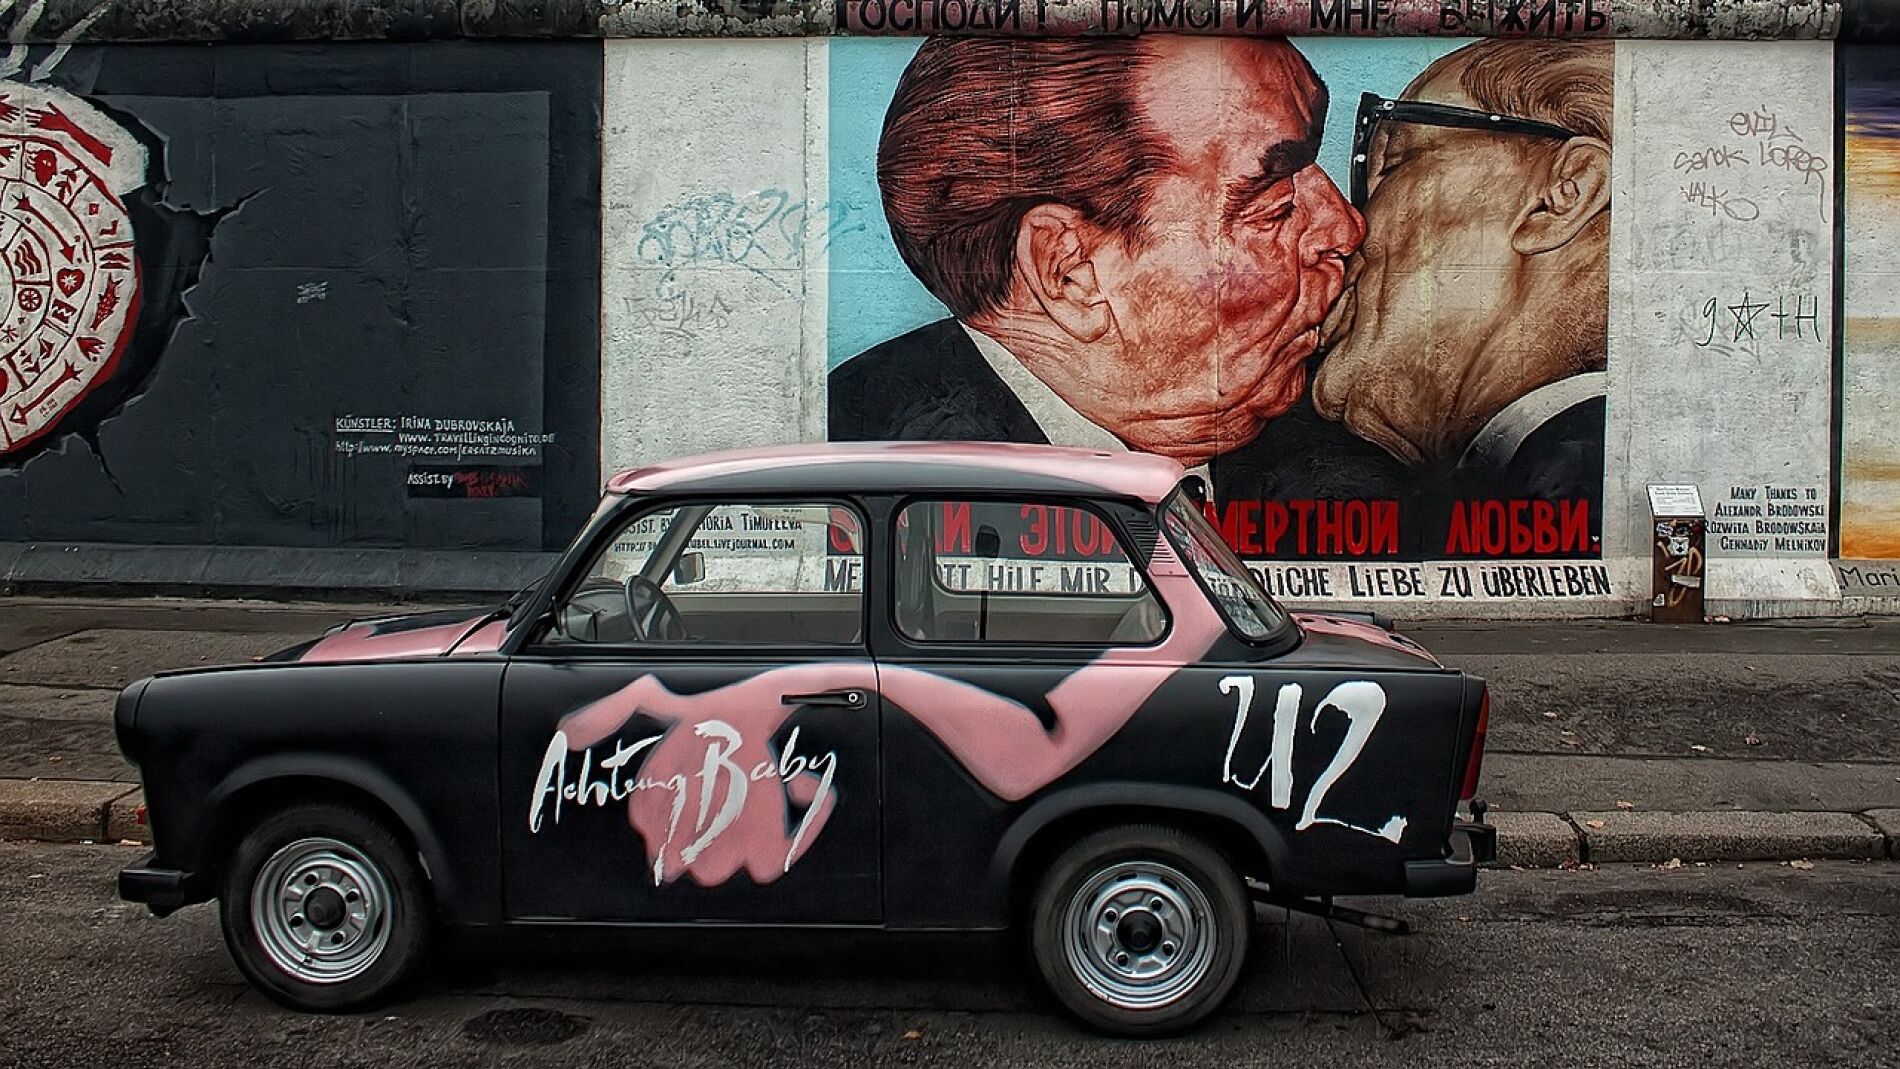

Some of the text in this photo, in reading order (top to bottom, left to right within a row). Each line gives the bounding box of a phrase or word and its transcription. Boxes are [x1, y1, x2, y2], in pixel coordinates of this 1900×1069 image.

[1730, 486, 1818, 500] MANY THANKS TO
[1437, 566, 1474, 598] ZU
[529, 719, 837, 887] Achtung Baby
[1218, 675, 1408, 844] U2
